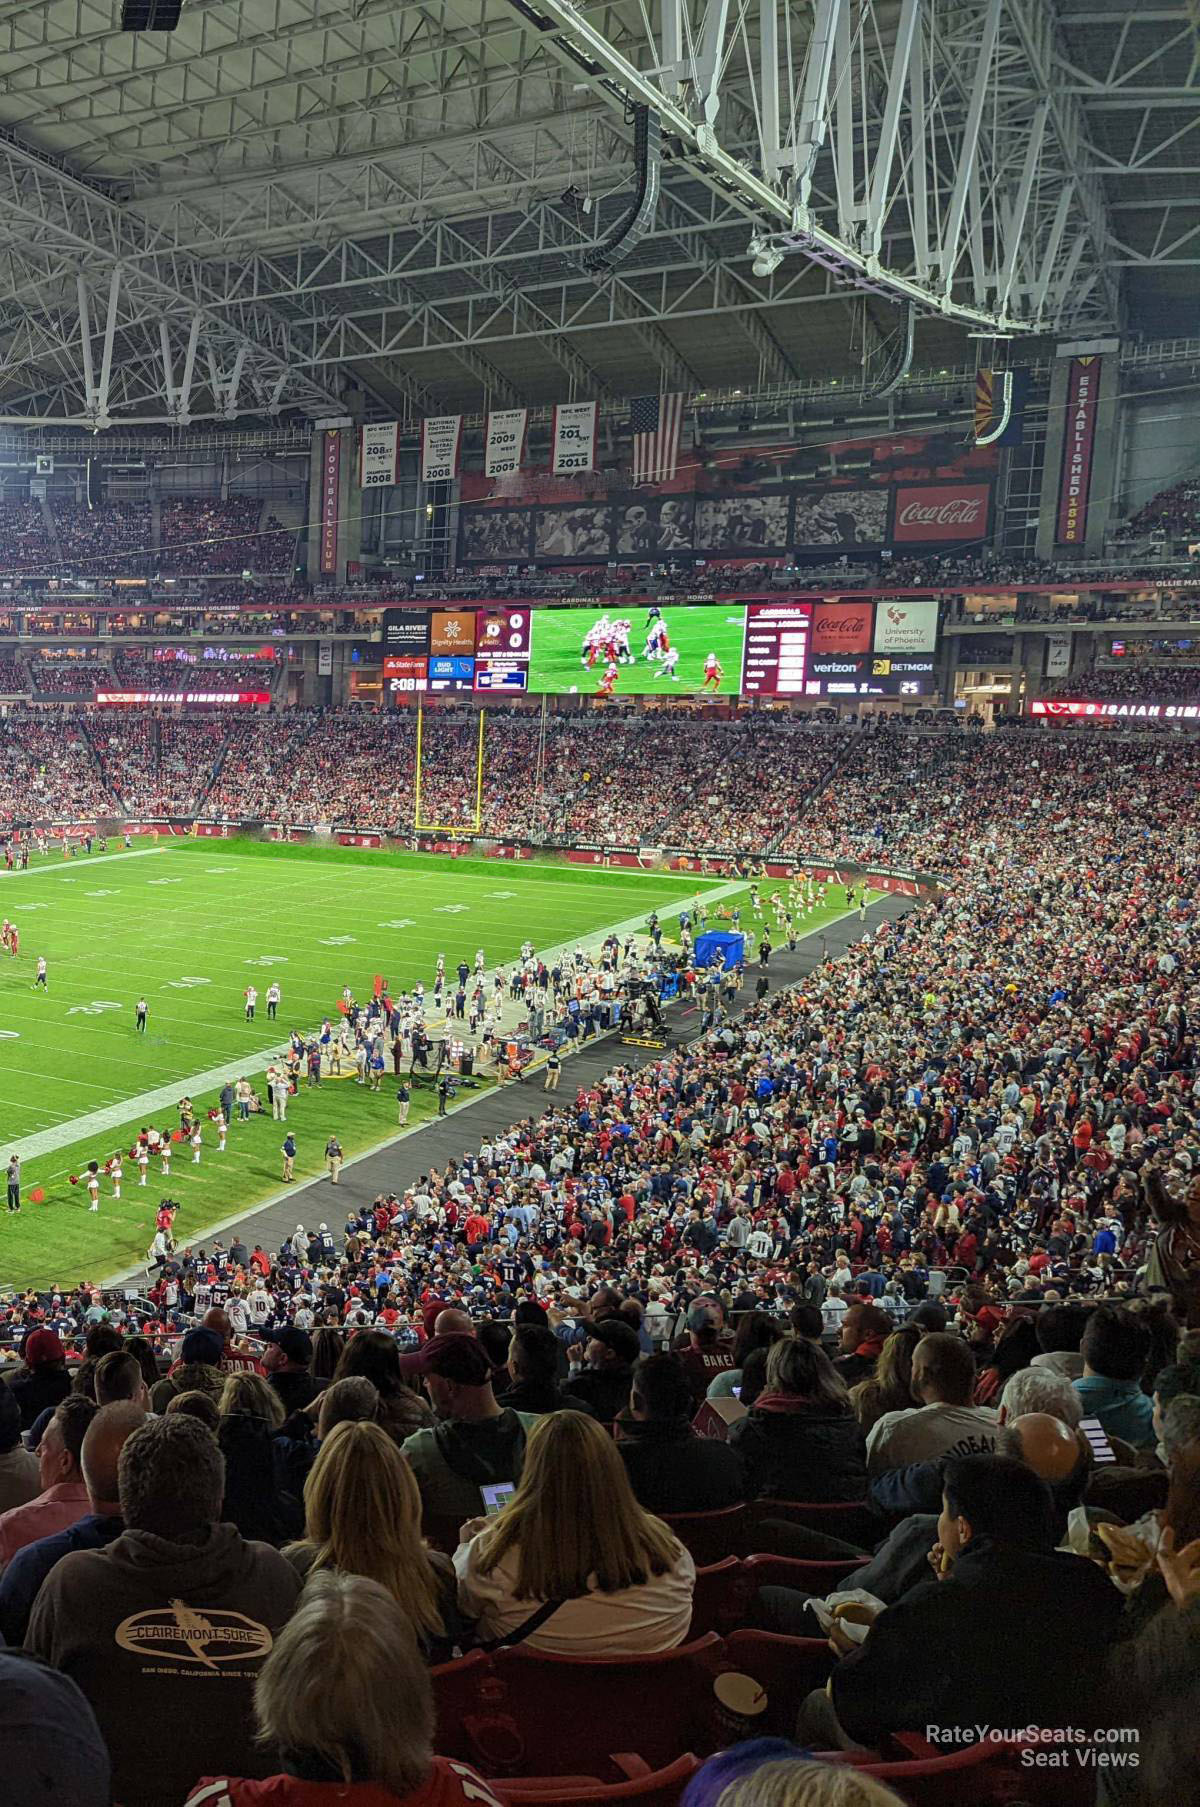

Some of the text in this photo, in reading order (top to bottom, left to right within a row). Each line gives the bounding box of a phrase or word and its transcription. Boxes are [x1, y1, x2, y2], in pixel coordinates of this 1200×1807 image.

[490, 434, 516, 445] 2009
[1068, 376, 1090, 495] ESTABLISHED
[489, 462, 515, 474] 2009
[558, 457, 588, 468] 2015
[366, 473, 392, 484] 2008
[426, 468, 451, 479] 2008
[327, 444, 336, 527] FOOTBALL
[900, 499, 984, 526] Coca-Cola
[1066, 497, 1078, 540] 1898
[325, 530, 333, 569] CLUB
[885, 628, 924, 637] University
[431, 639, 453, 647] Dignity
[813, 662, 857, 673] verizon
[890, 663, 933, 671] BETMGM
[1101, 705, 1160, 716] ISAIAH
[1165, 706, 1200, 717] SIM
[67, 1000, 123, 1015] 30
[503, 1268, 514, 1281] 11
[255, 1300, 266, 1312] 10
[136, 1626, 253, 1642] CLAIREMONT SURF
[180, 1669, 220, 1677] CALIFORNIA
